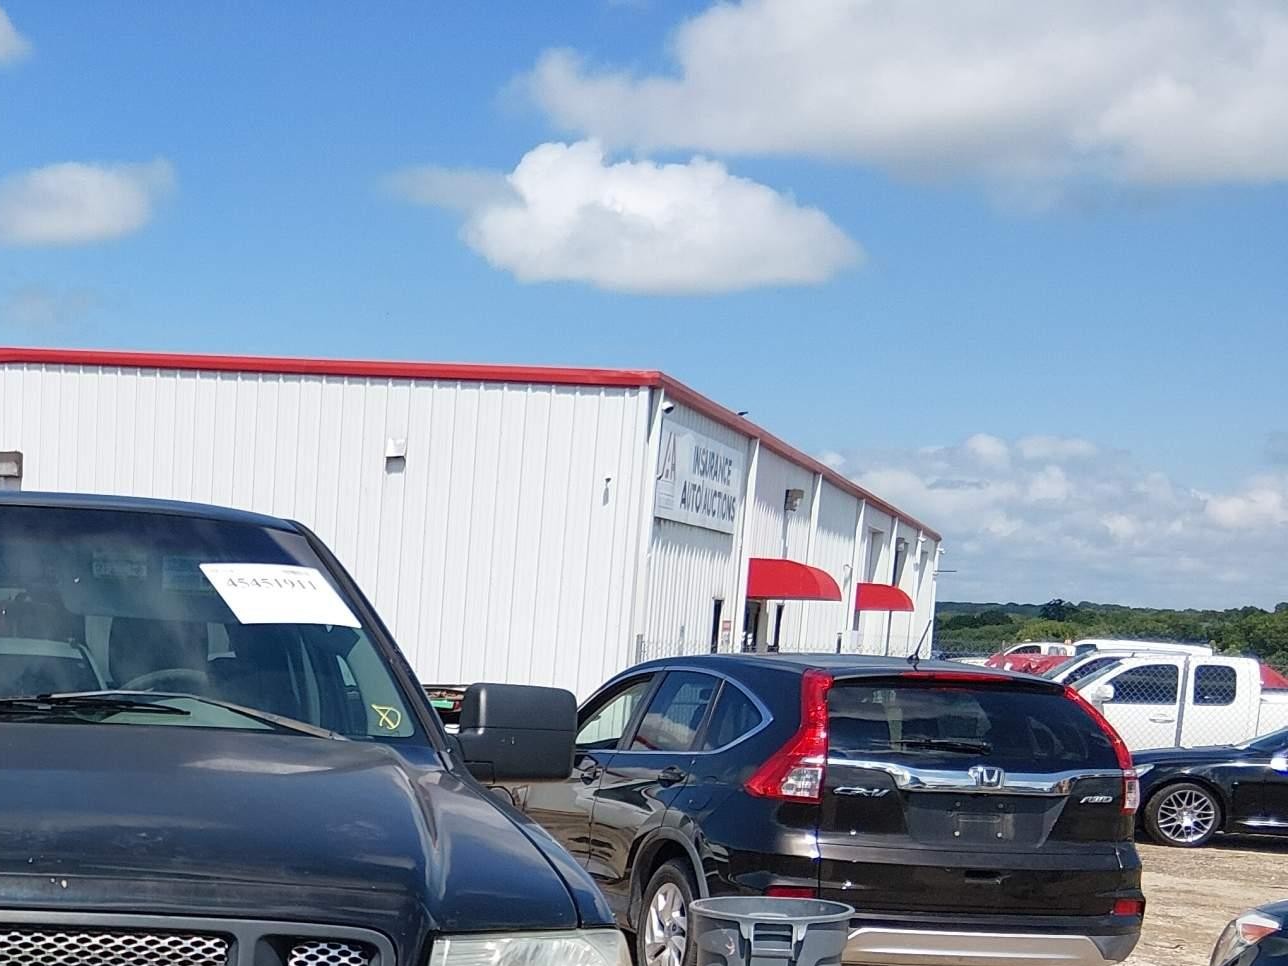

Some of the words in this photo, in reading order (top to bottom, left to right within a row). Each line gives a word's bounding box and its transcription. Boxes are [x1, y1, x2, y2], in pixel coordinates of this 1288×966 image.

[692, 445, 733, 487] INSURANCE
[679, 479, 702, 514] AUTO
[701, 487, 737, 523] AUCTIONS
[226, 576, 319, 591] 45451911
